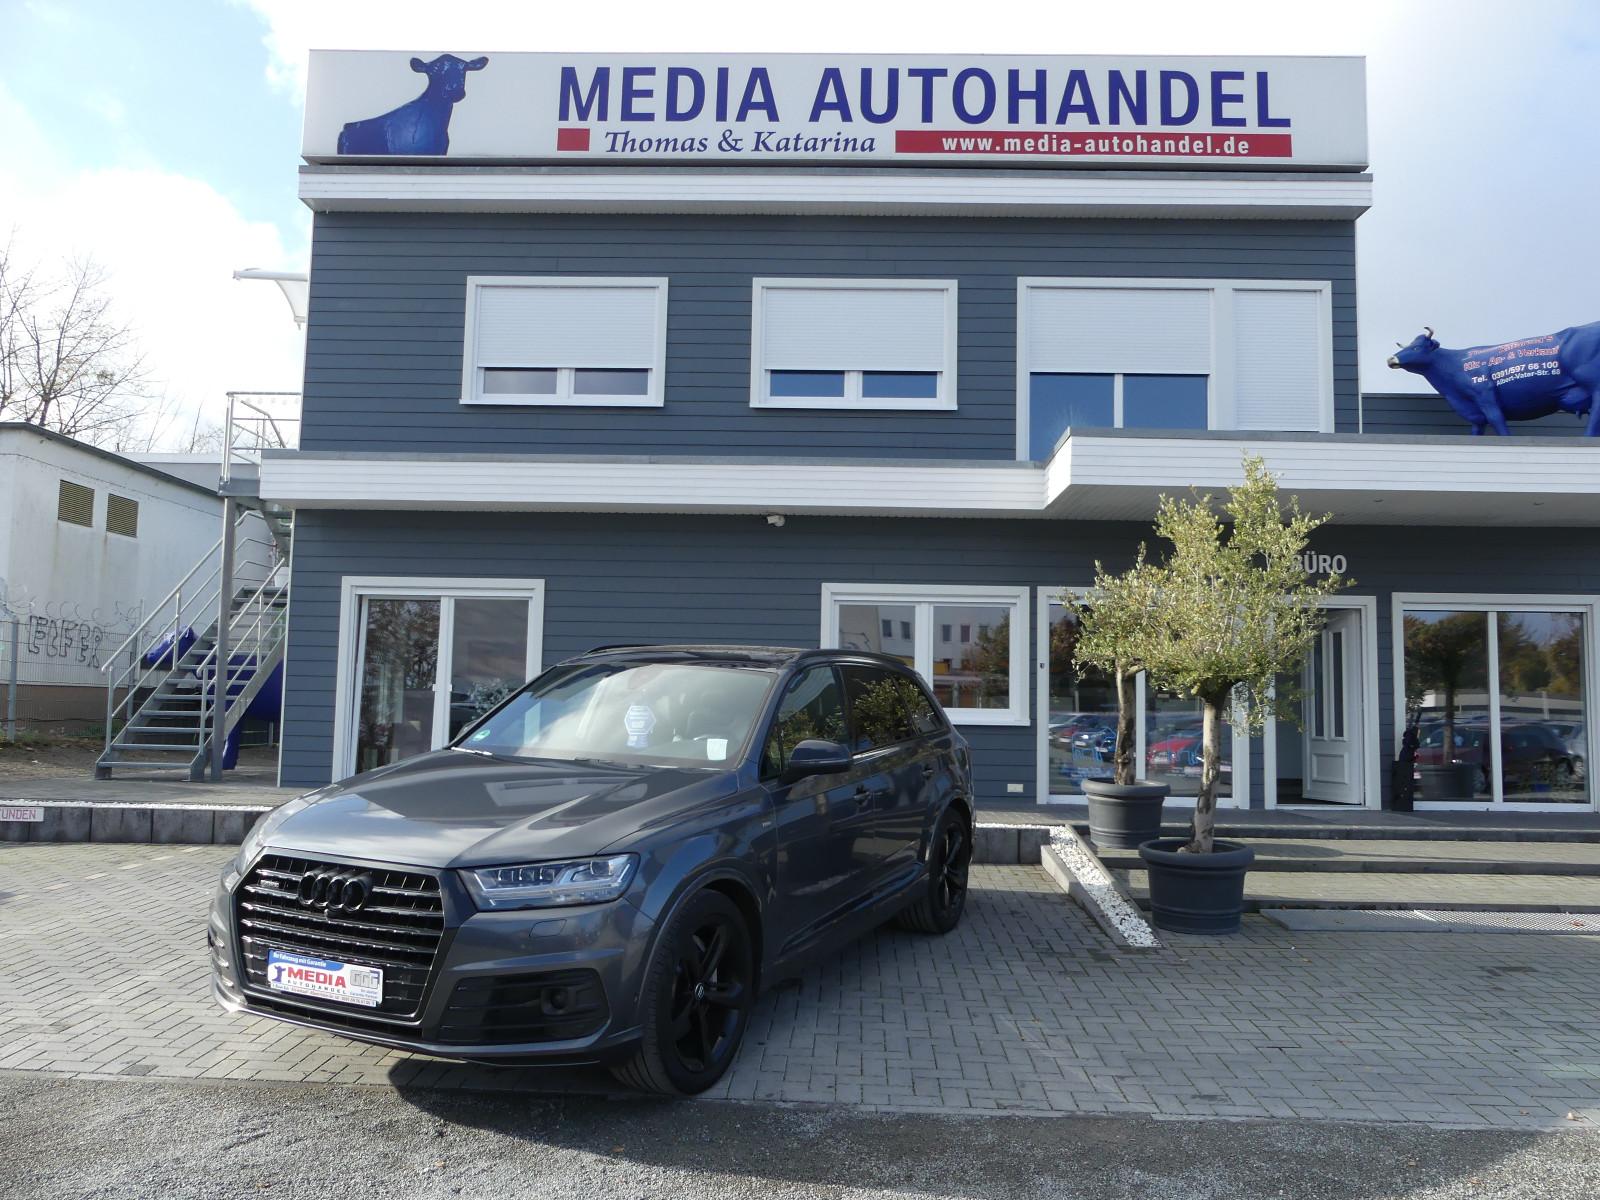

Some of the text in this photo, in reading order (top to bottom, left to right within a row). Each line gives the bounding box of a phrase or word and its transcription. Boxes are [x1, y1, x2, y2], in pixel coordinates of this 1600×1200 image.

[558, 66, 1291, 128] MEDIA AUTOHANDEL
[604, 128, 876, 153] Thomas & Katarina
[942, 133, 1250, 154] www.media-autohandel.de
[1471, 374, 1488, 384] Tel.
[1541, 361, 1559, 369] 100
[1496, 369, 1550, 386] Albert-Vater-Str.
[1289, 551, 1347, 574] BÜRO
[287, 966, 347, 988] MEDIA
[287, 979, 347, 994] AUTOHANDEL
